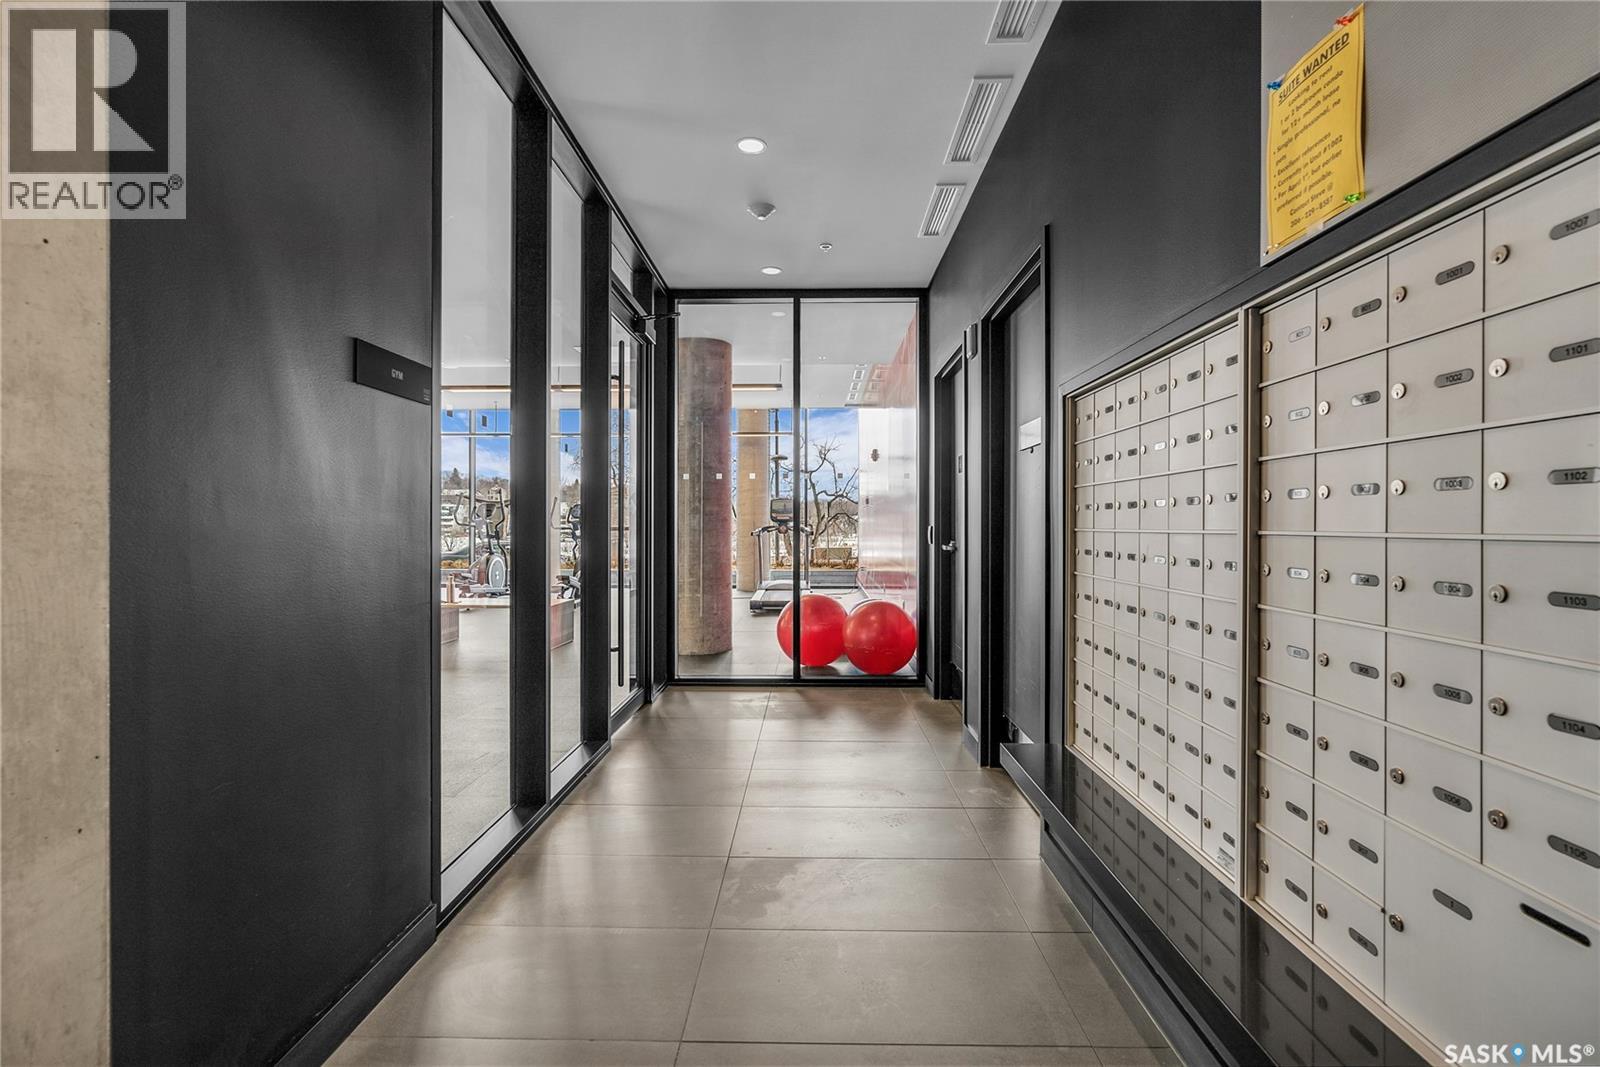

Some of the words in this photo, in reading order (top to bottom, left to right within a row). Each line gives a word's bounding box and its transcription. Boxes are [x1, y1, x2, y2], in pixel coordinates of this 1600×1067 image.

[1279, 74, 1300, 103] SUITE
[1302, 33, 1349, 77] WANTED
[1319, 65, 1332, 80] rent
[1284, 114, 1290, 122] or
[1296, 88, 1321, 112] bedroom
[1323, 70, 1344, 88] condo
[1303, 101, 1321, 118] month
[1323, 85, 1340, 101] lease
[1302, 132, 1331, 157] references
[1288, 178, 1301, 192] April
[1311, 165, 1321, 175] but
[1322, 149, 1343, 168] earlier
[1277, 191, 1302, 212] preferred
[1311, 189, 1326, 203] Steve
[1565, 216, 1590, 231] 1007
[1446, 267, 1463, 280] 1001
[1565, 344, 1588, 356] 1101
[391, 368, 404, 380] GYM
[1445, 373, 1463, 384] 1002
[1564, 471, 1588, 481] 1102
[1563, 595, 1588, 606] 1103
[1562, 721, 1586, 734] 1104
